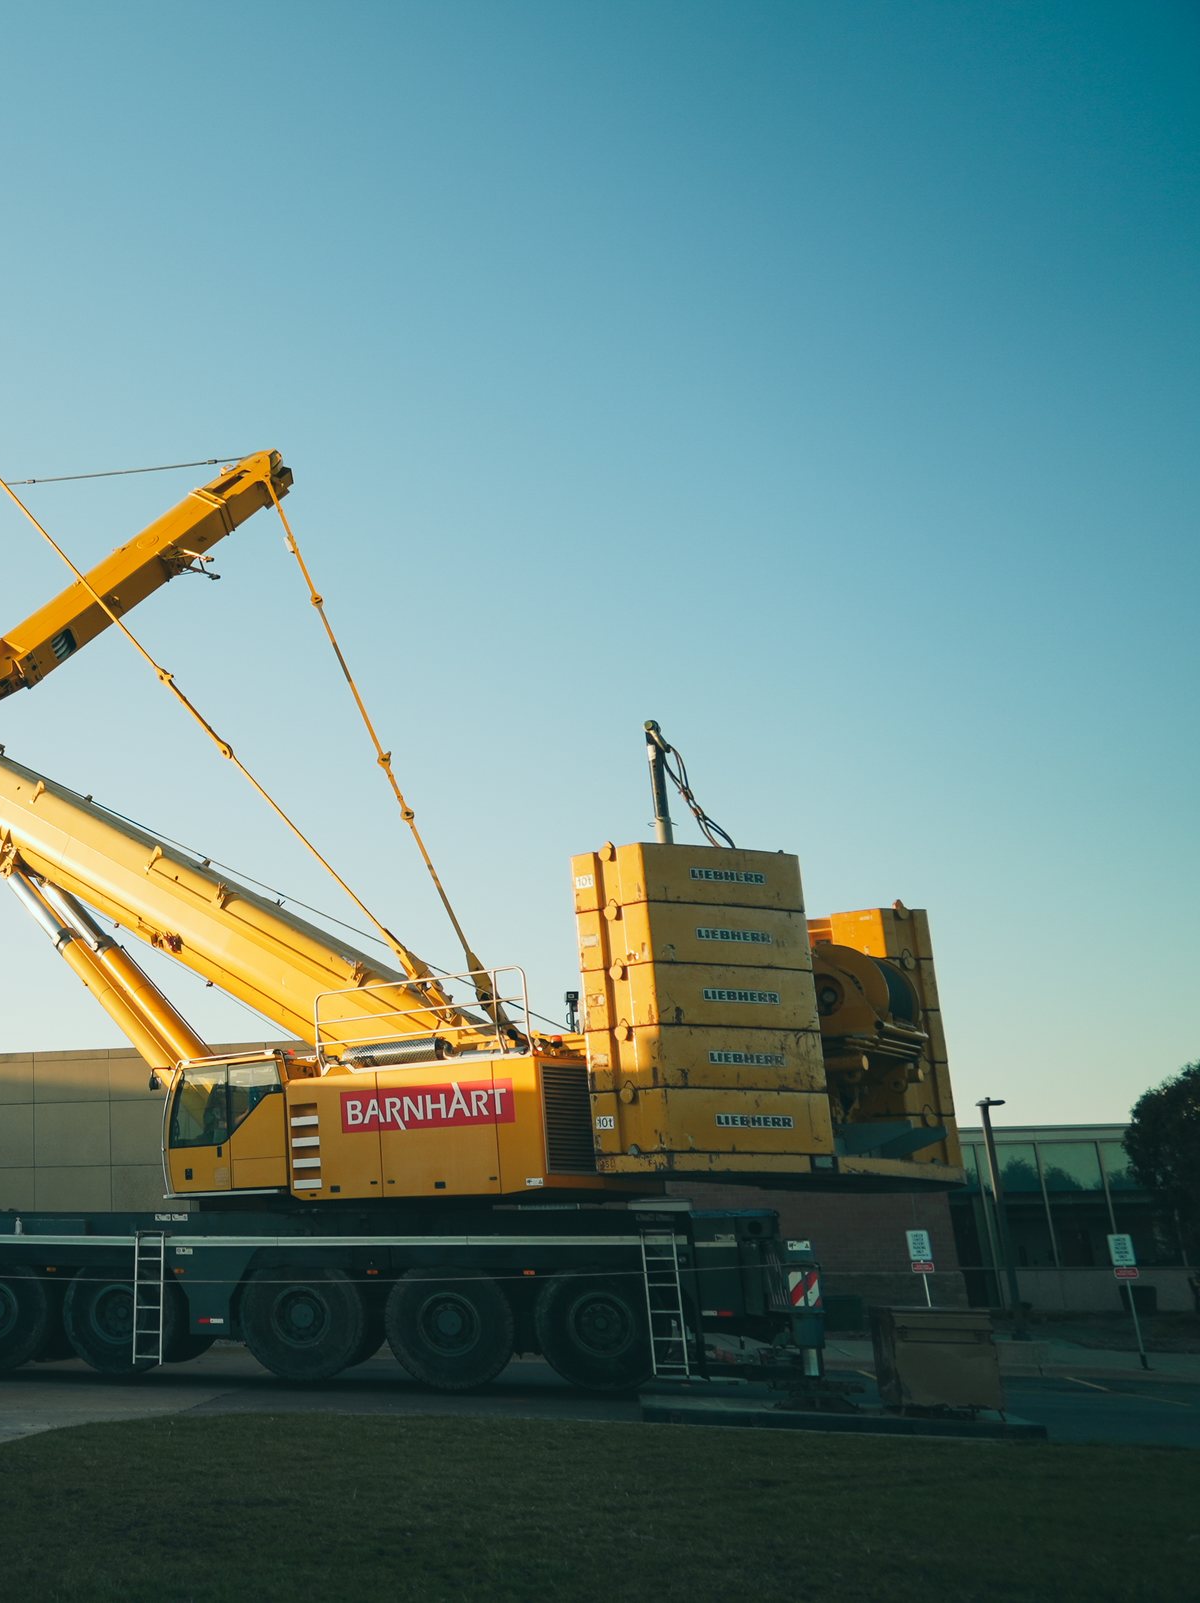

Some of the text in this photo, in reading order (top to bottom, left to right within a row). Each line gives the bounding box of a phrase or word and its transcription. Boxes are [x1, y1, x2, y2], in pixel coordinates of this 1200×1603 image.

[691, 869, 765, 884] LIEBHERR
[697, 929, 771, 944] LIEBHERR
[704, 990, 779, 1004] LIEBHERR
[709, 1052, 785, 1066] LIEBHERR
[346, 1081, 507, 1130] BARNHART
[716, 1115, 793, 1128] LIEBHERR
